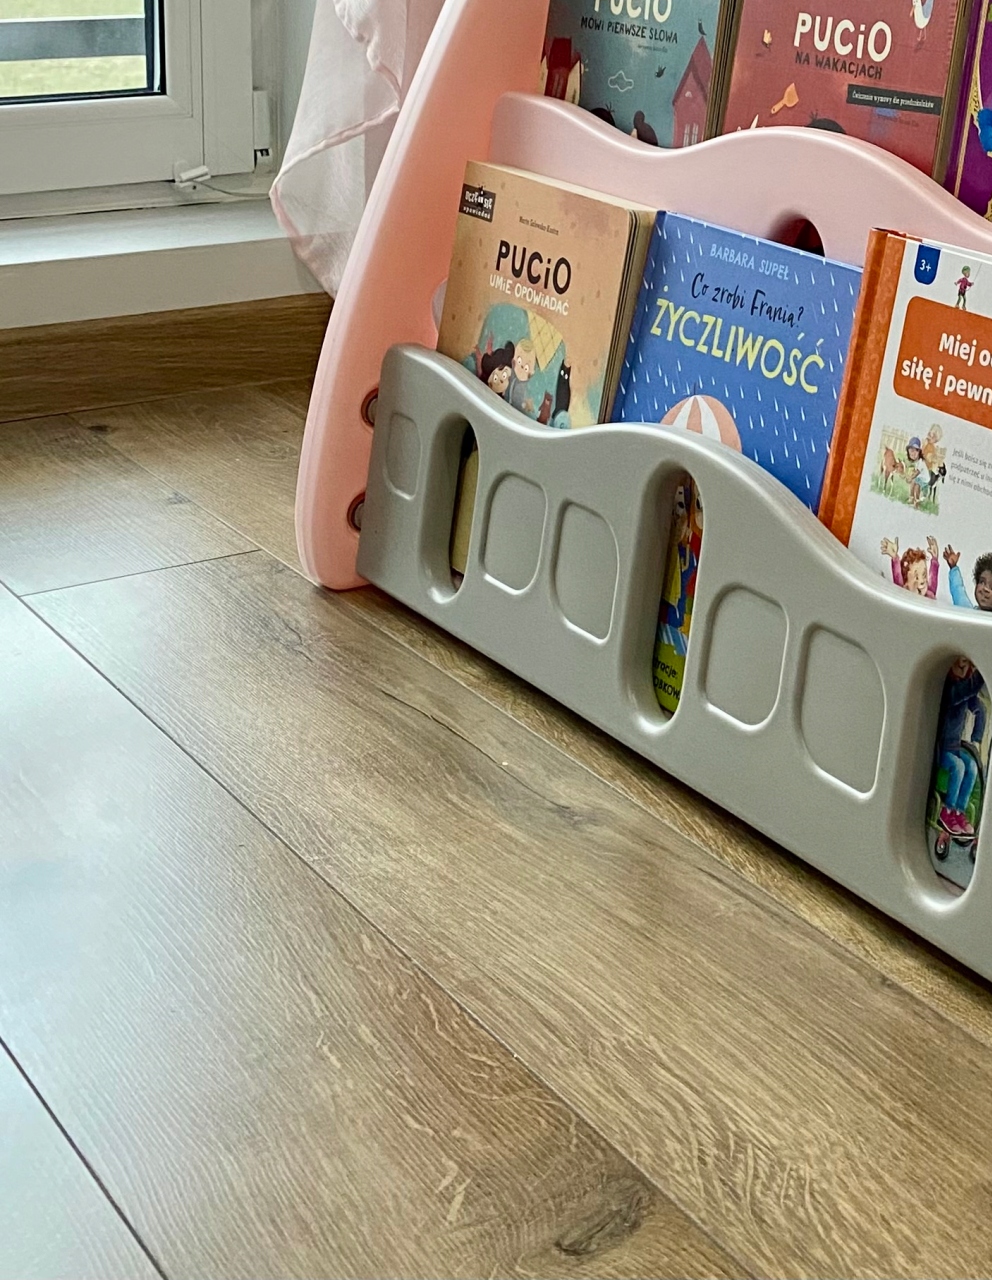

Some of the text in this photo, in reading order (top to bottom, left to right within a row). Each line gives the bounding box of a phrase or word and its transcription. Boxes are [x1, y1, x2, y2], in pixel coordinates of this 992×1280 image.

[649, 28, 678, 44] SŁOWA
[795, 51, 810, 65] NA
[710, 243, 789, 281] BARBARA SUPEŁ
[919, 260, 932, 272] 3+
[691, 273, 709, 299] Co
[712, 285, 747, 310] zrobi
[650, 285, 825, 394] ŻYCZLIWOŚĆ
[939, 332, 978, 367] Miej
[901, 356, 933, 390] siłę
[936, 369, 944, 388] i
